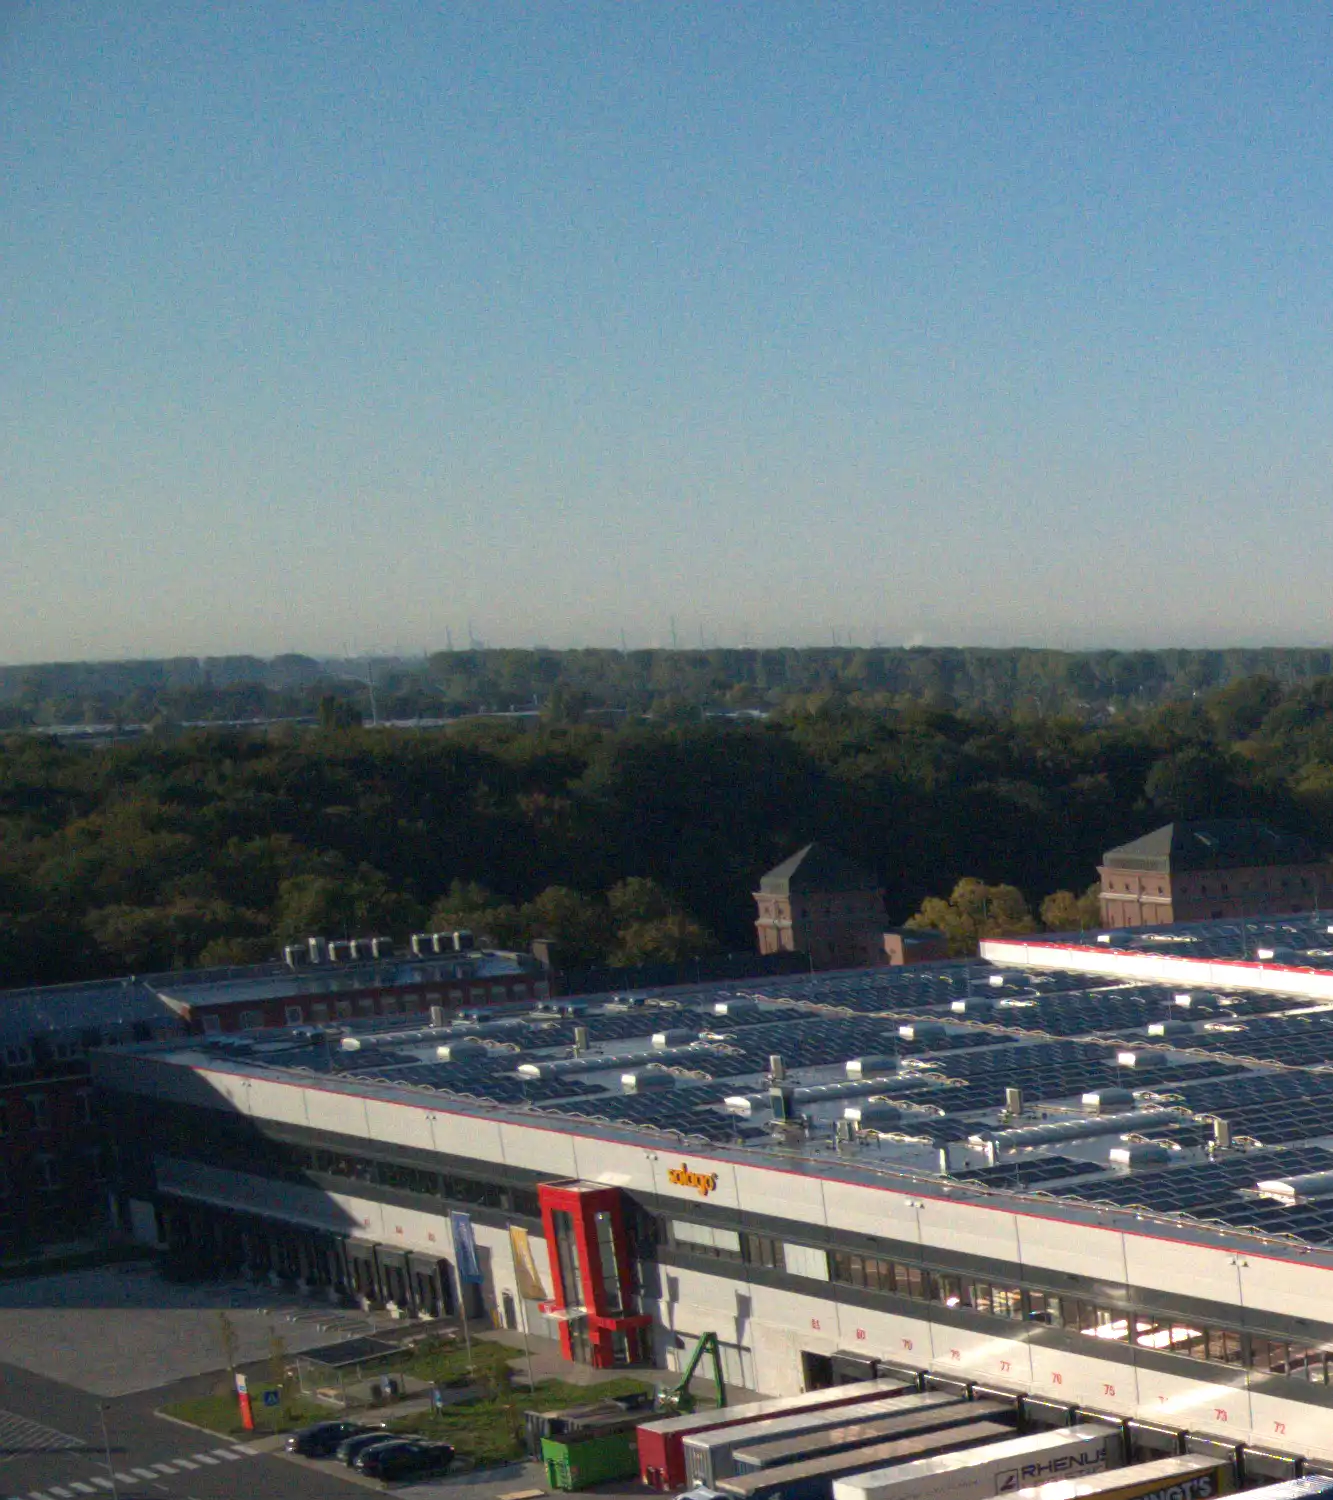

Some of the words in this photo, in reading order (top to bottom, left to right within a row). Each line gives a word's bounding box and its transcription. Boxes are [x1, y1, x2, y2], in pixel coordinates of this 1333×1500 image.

[668, 1163, 717, 1197] solago
[1214, 1408, 1228, 1422] 73
[1273, 1421, 1286, 1435] 72
